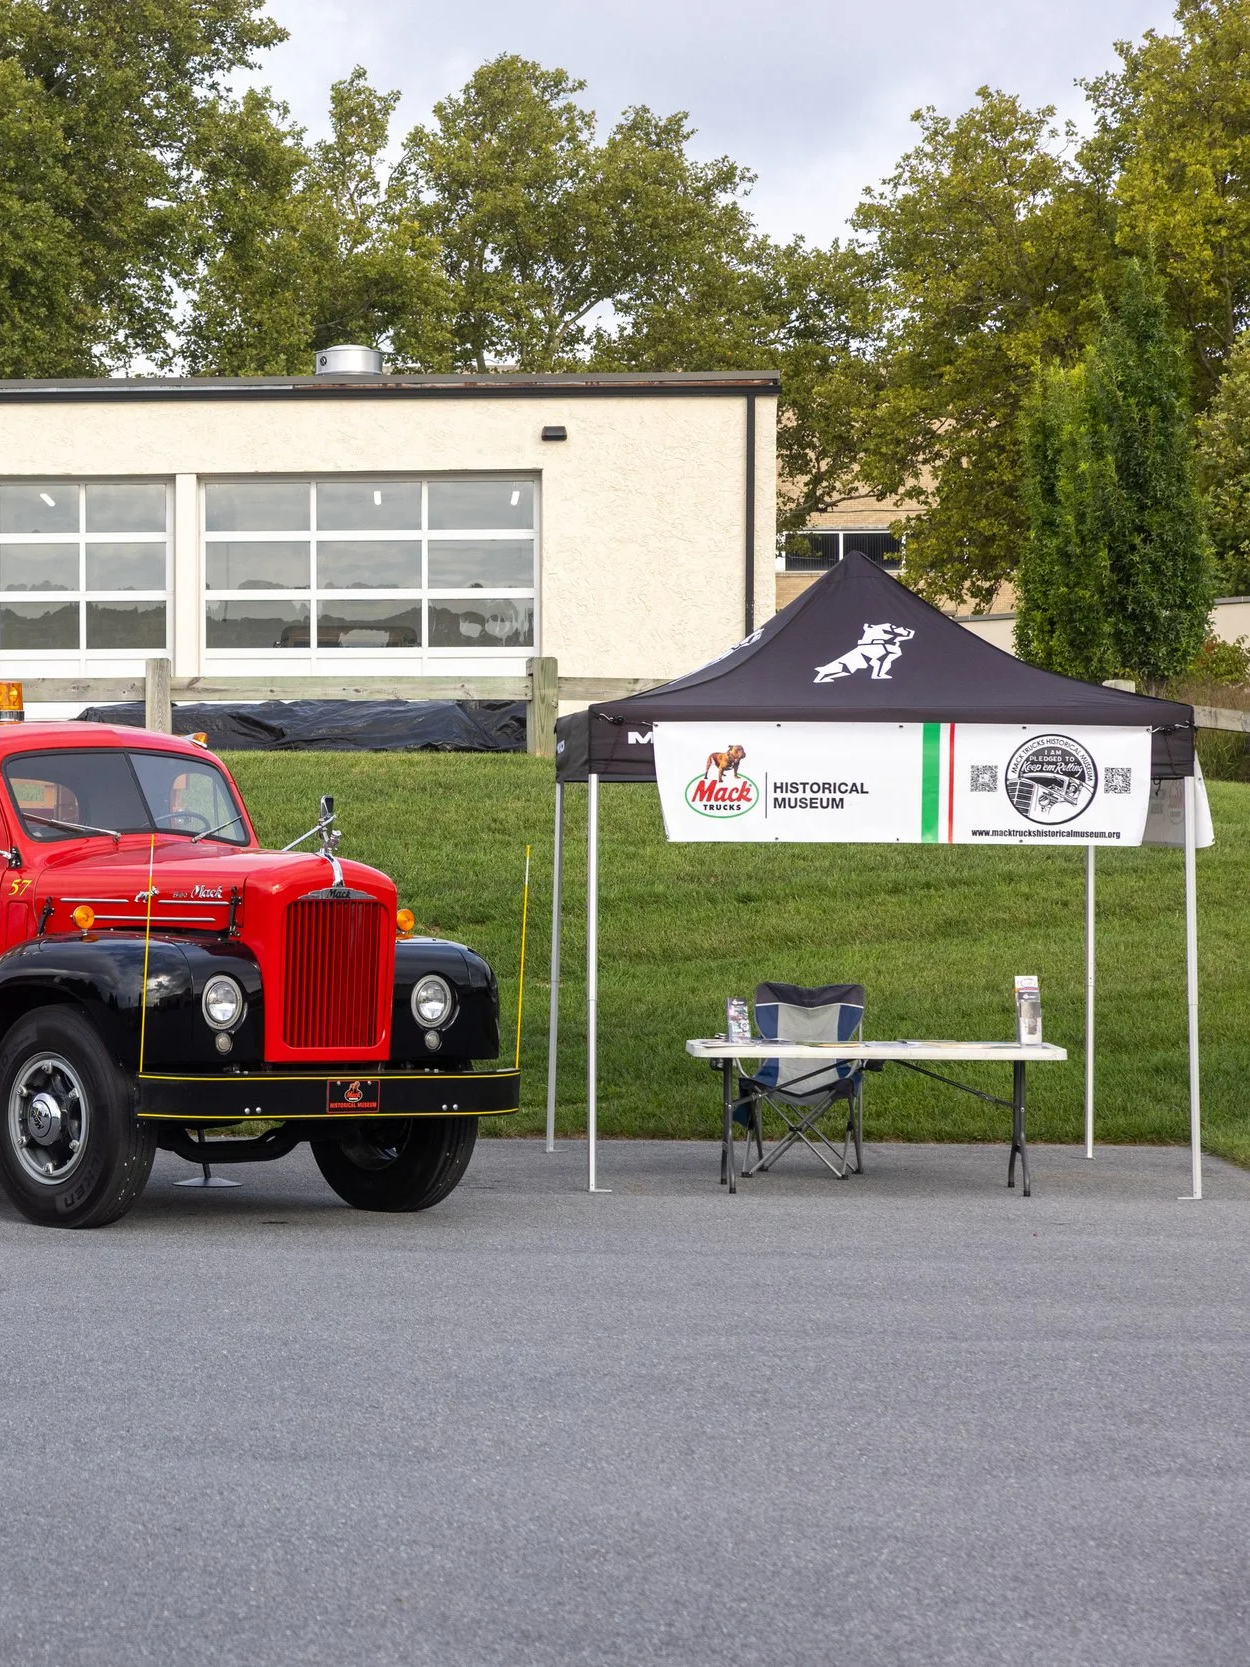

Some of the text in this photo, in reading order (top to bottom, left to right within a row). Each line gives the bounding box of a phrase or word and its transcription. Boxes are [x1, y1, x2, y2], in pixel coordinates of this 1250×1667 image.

[1011, 738, 1094, 782] MACK TRUCKS HISTORICAL MUSEUM
[1021, 760, 1042, 773] Keep
[1054, 761, 1084, 778] Rolling
[691, 780, 753, 803] Mack
[773, 781, 869, 795] HISTORICAL
[773, 797, 845, 810] MUSEUM
[971, 829, 1122, 839] www.macktruckshistoricalmuseum.org
[8, 879, 32, 896] 57
[191, 884, 223, 899] Mack
[327, 889, 351, 899] Mack
